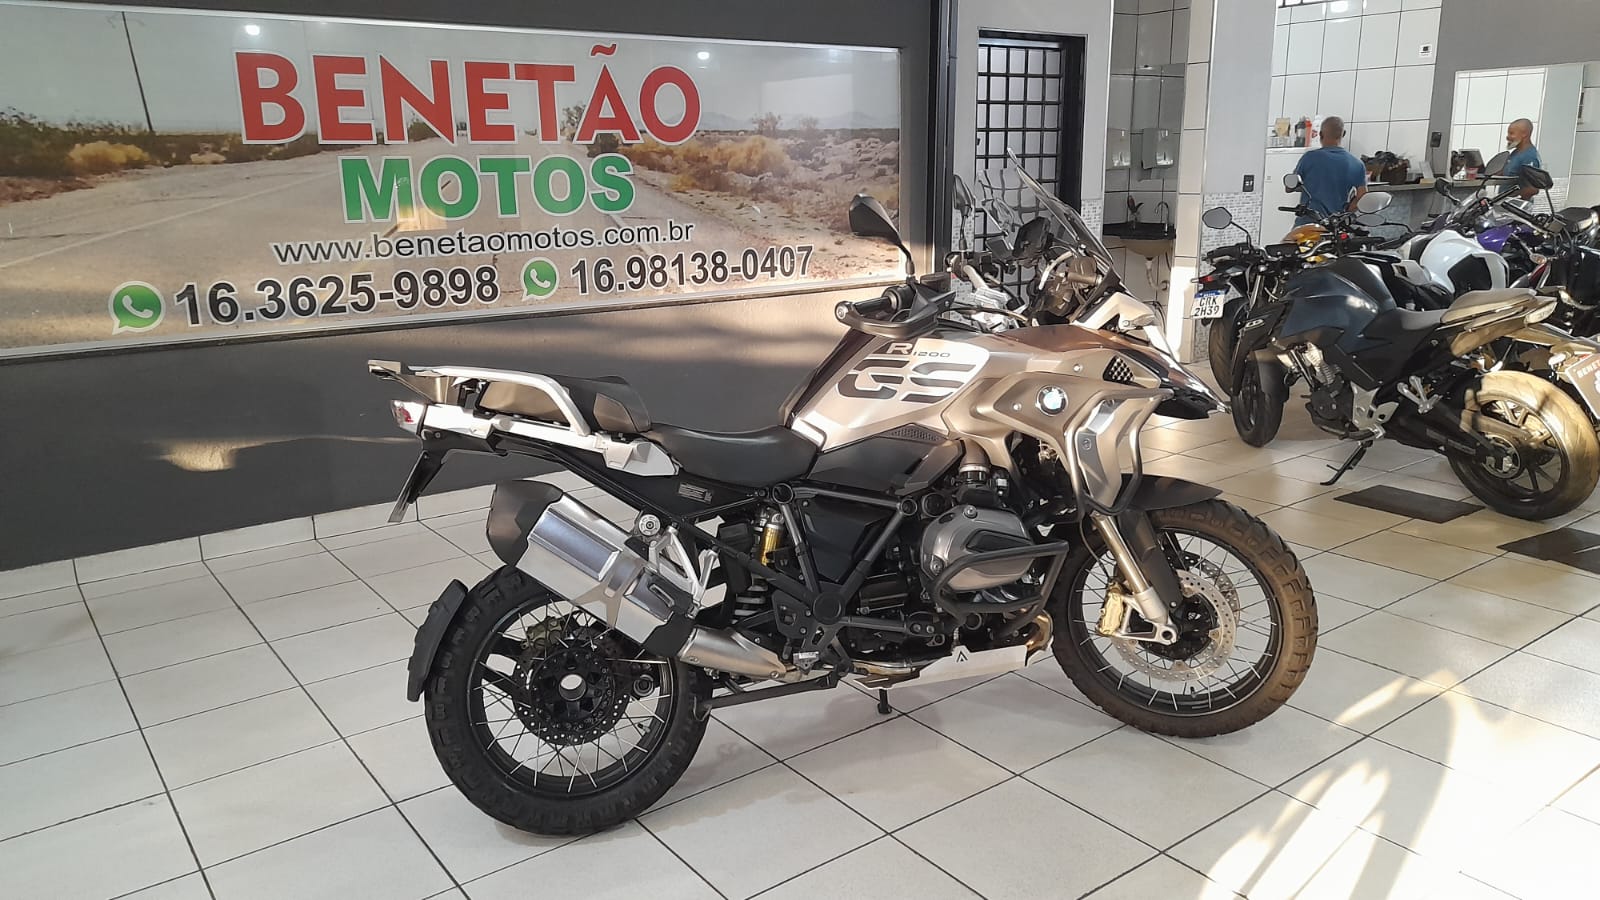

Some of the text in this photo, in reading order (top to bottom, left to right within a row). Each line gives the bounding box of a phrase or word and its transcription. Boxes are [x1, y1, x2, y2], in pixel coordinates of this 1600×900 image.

[235, 43, 702, 146] BENETÃO
[340, 154, 635, 223] MOTOS
[272, 221, 694, 264] www.benetaomotos.com.br
[570, 245, 814, 295] 16.98138-0407
[174, 265, 500, 326] 16.3625-9898
[886, 342, 913, 355] R
[837, 358, 977, 404] GS
